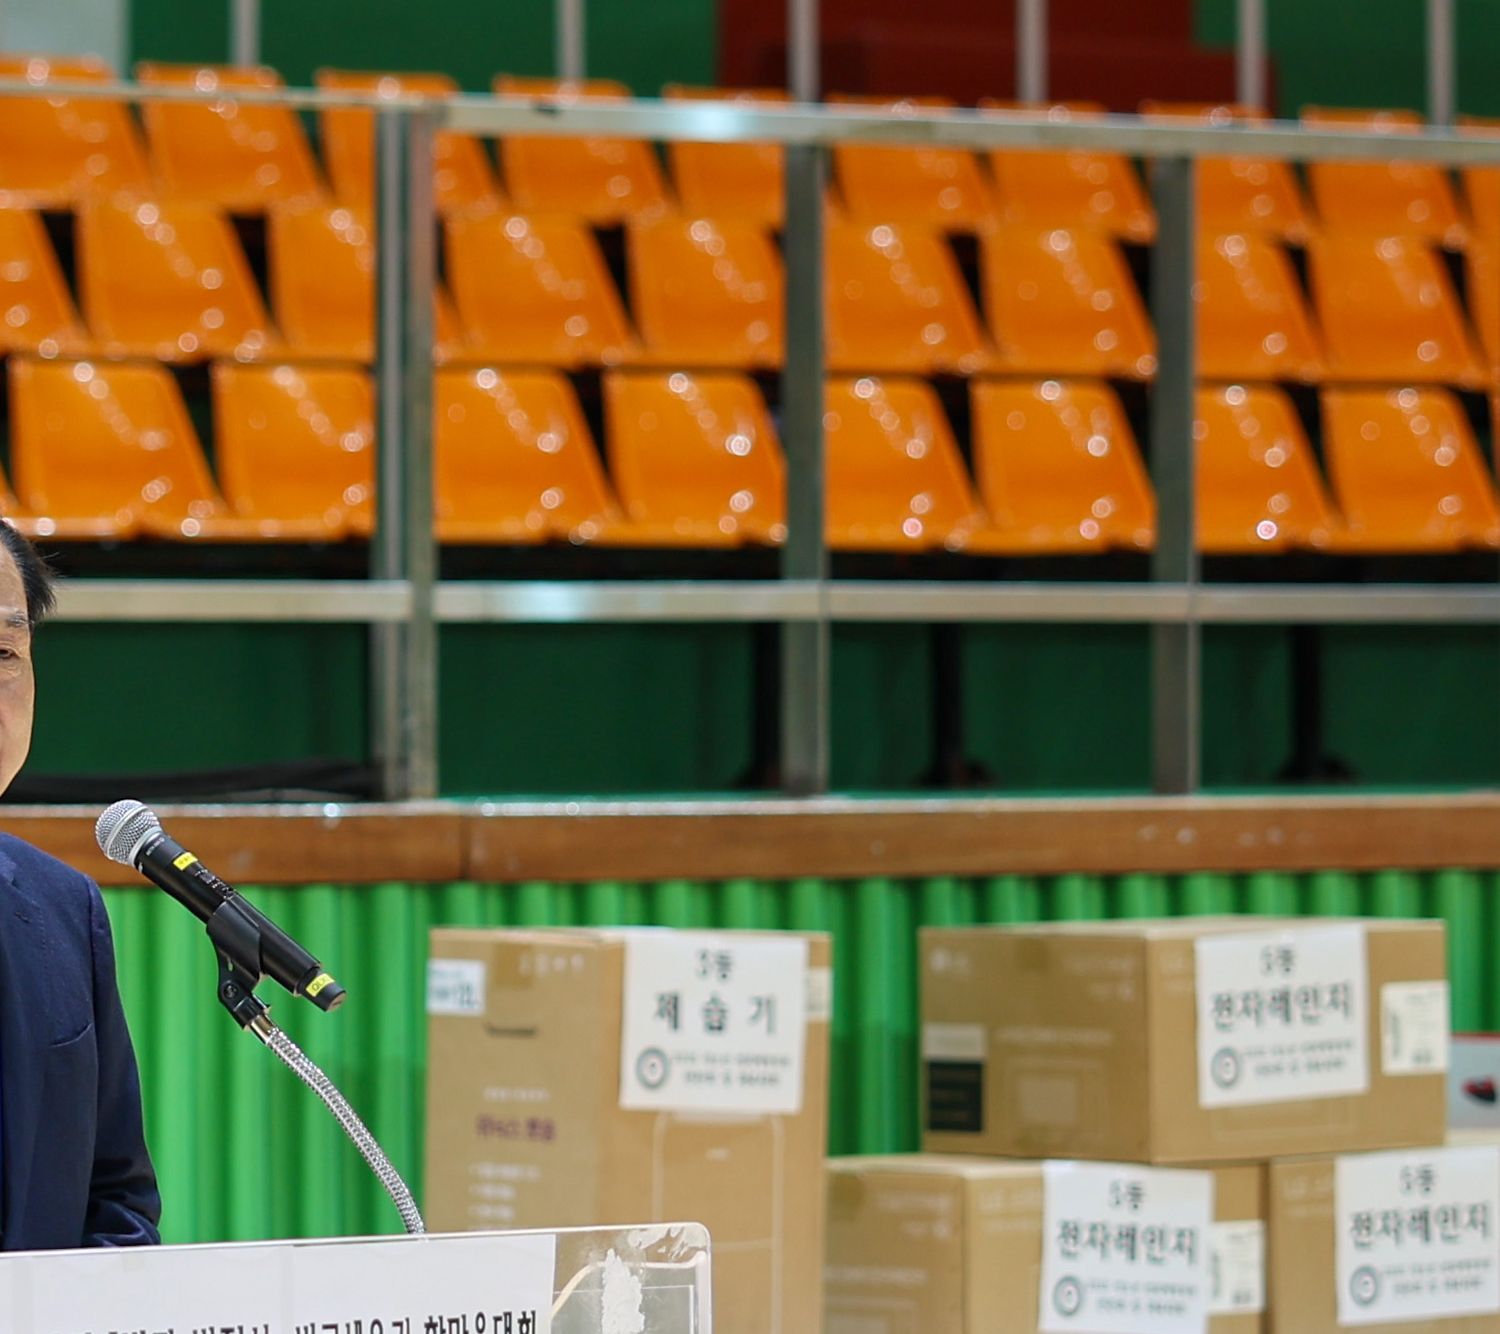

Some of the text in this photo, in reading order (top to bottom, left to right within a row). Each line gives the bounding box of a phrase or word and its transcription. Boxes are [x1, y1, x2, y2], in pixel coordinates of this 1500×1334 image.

[1210, 983, 1353, 1032] 전자레인지
[1055, 1218, 1200, 1265] 전자레인지
[1349, 1201, 1491, 1250] 전자레인지
